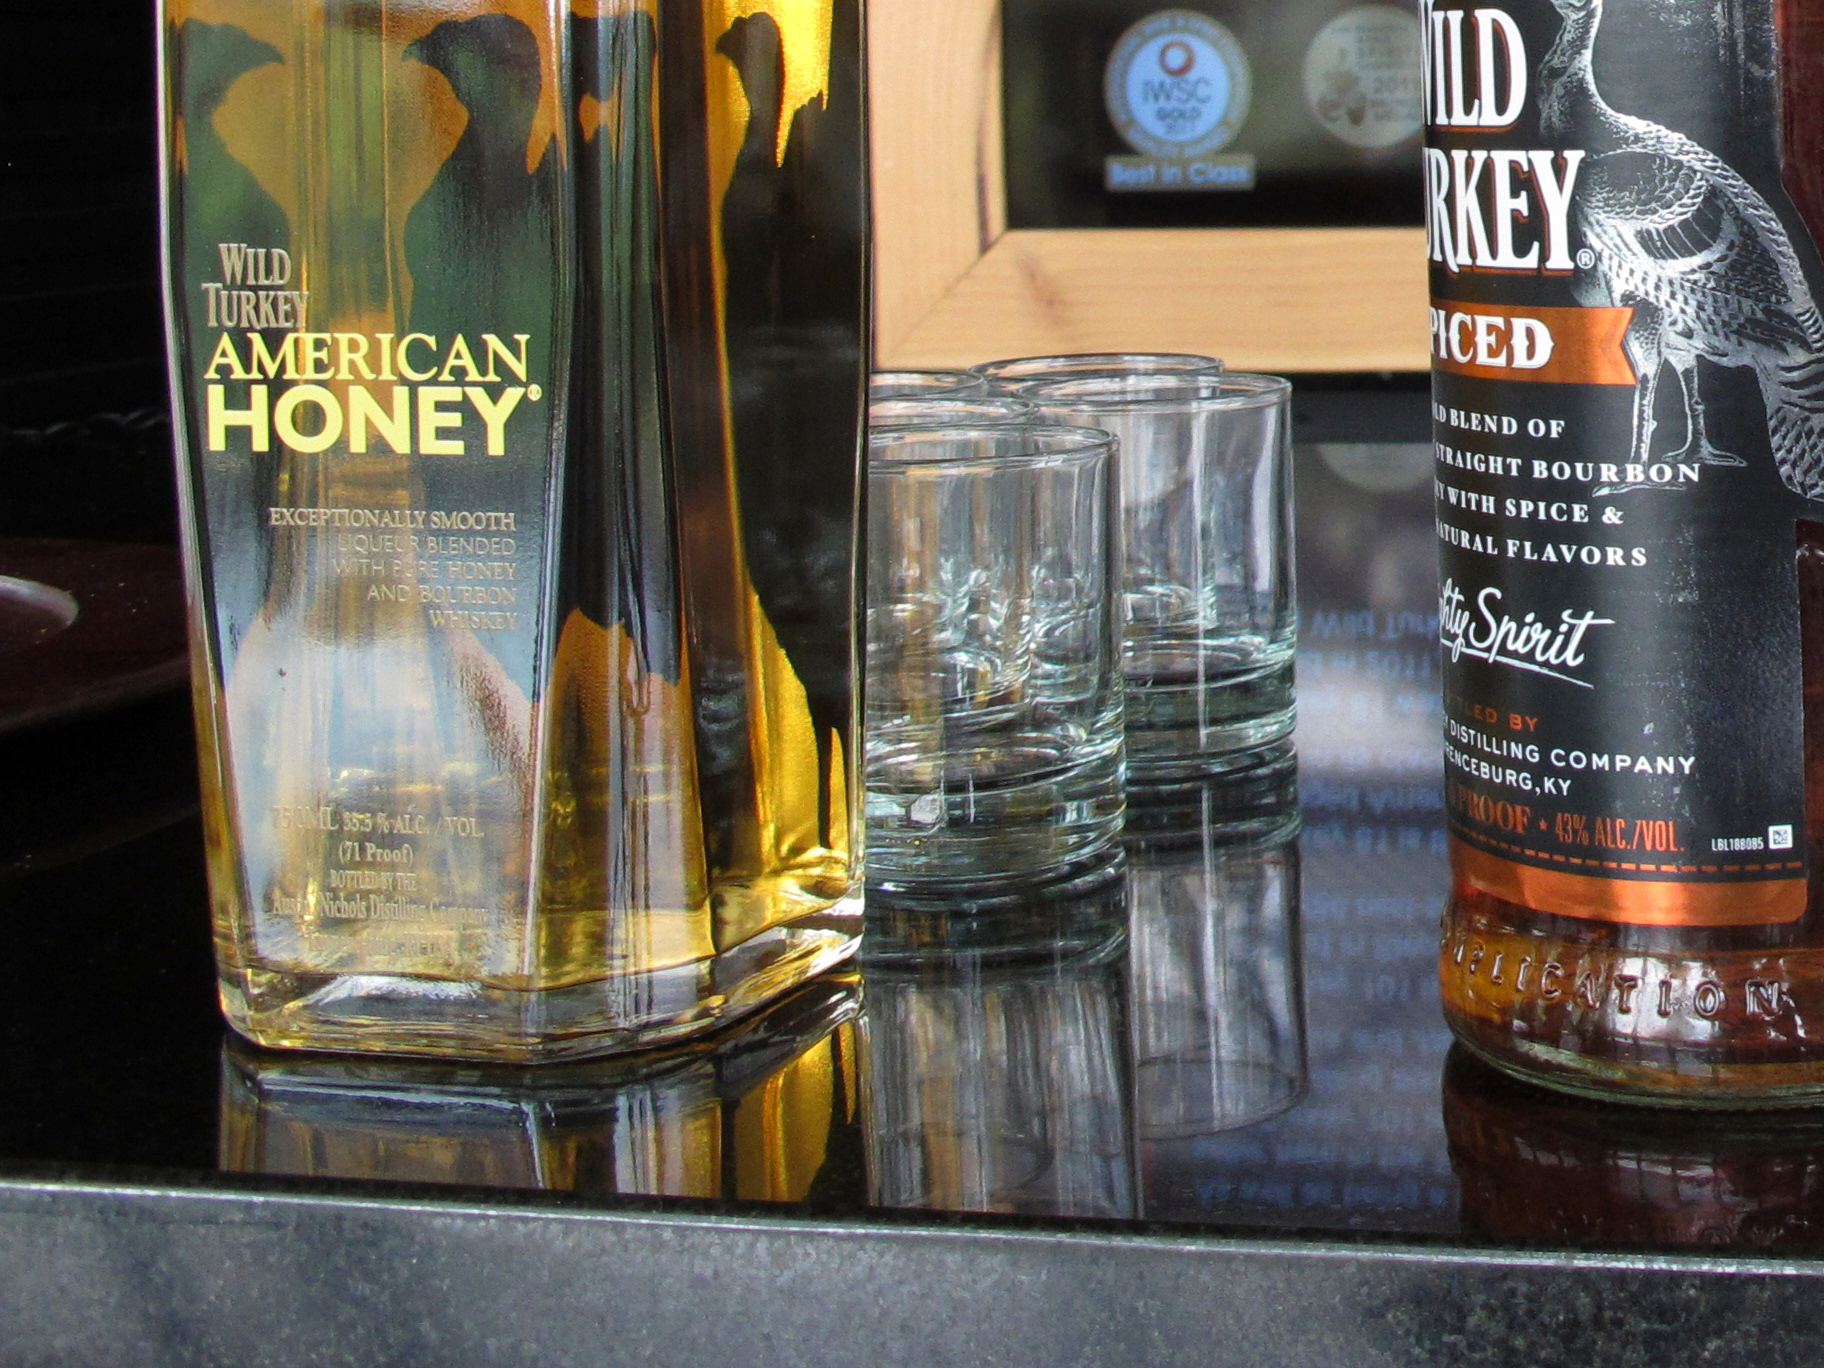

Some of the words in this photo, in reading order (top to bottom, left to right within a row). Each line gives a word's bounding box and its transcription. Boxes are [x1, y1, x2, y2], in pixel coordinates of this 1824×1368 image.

[1141, 76, 1213, 104] IWSC
[1108, 161, 1157, 185] Best
[217, 242, 293, 287] WILD
[201, 282, 310, 331] TURKEY
[203, 331, 533, 383] AMERICAN
[206, 383, 528, 457] HONEY
[1450, 405, 1519, 436] BLEND
[1527, 417, 1567, 439] OF
[1531, 458, 1702, 483] BOURBON
[268, 507, 427, 531] EXCEPTIONALLY
[430, 511, 517, 532] SMOOTH
[1448, 485, 1497, 516] WITH
[1504, 498, 1590, 524] SPICE
[1600, 504, 1626, 526] &
[338, 534, 421, 554] LIQUEUR
[427, 537, 517, 556] BLENDED
[1505, 538, 1649, 568] FLAVORS
[448, 561, 518, 582] HONEY
[367, 584, 411, 603] AND
[418, 585, 518, 606] BOURBON
[428, 609, 519, 631] WHISKEY
[1468, 586, 1617, 669] Spirit
[1507, 712, 1540, 733] BY
[1450, 719, 1541, 764] DISTILLING
[1549, 747, 1697, 776] COMPANY
[1554, 811, 1590, 847] 43%
[1594, 816, 1686, 853] ALC./VOL.
[339, 840, 361, 865] (71
[365, 842, 414, 866] Proof)
[319, 891, 367, 920] Nichols
